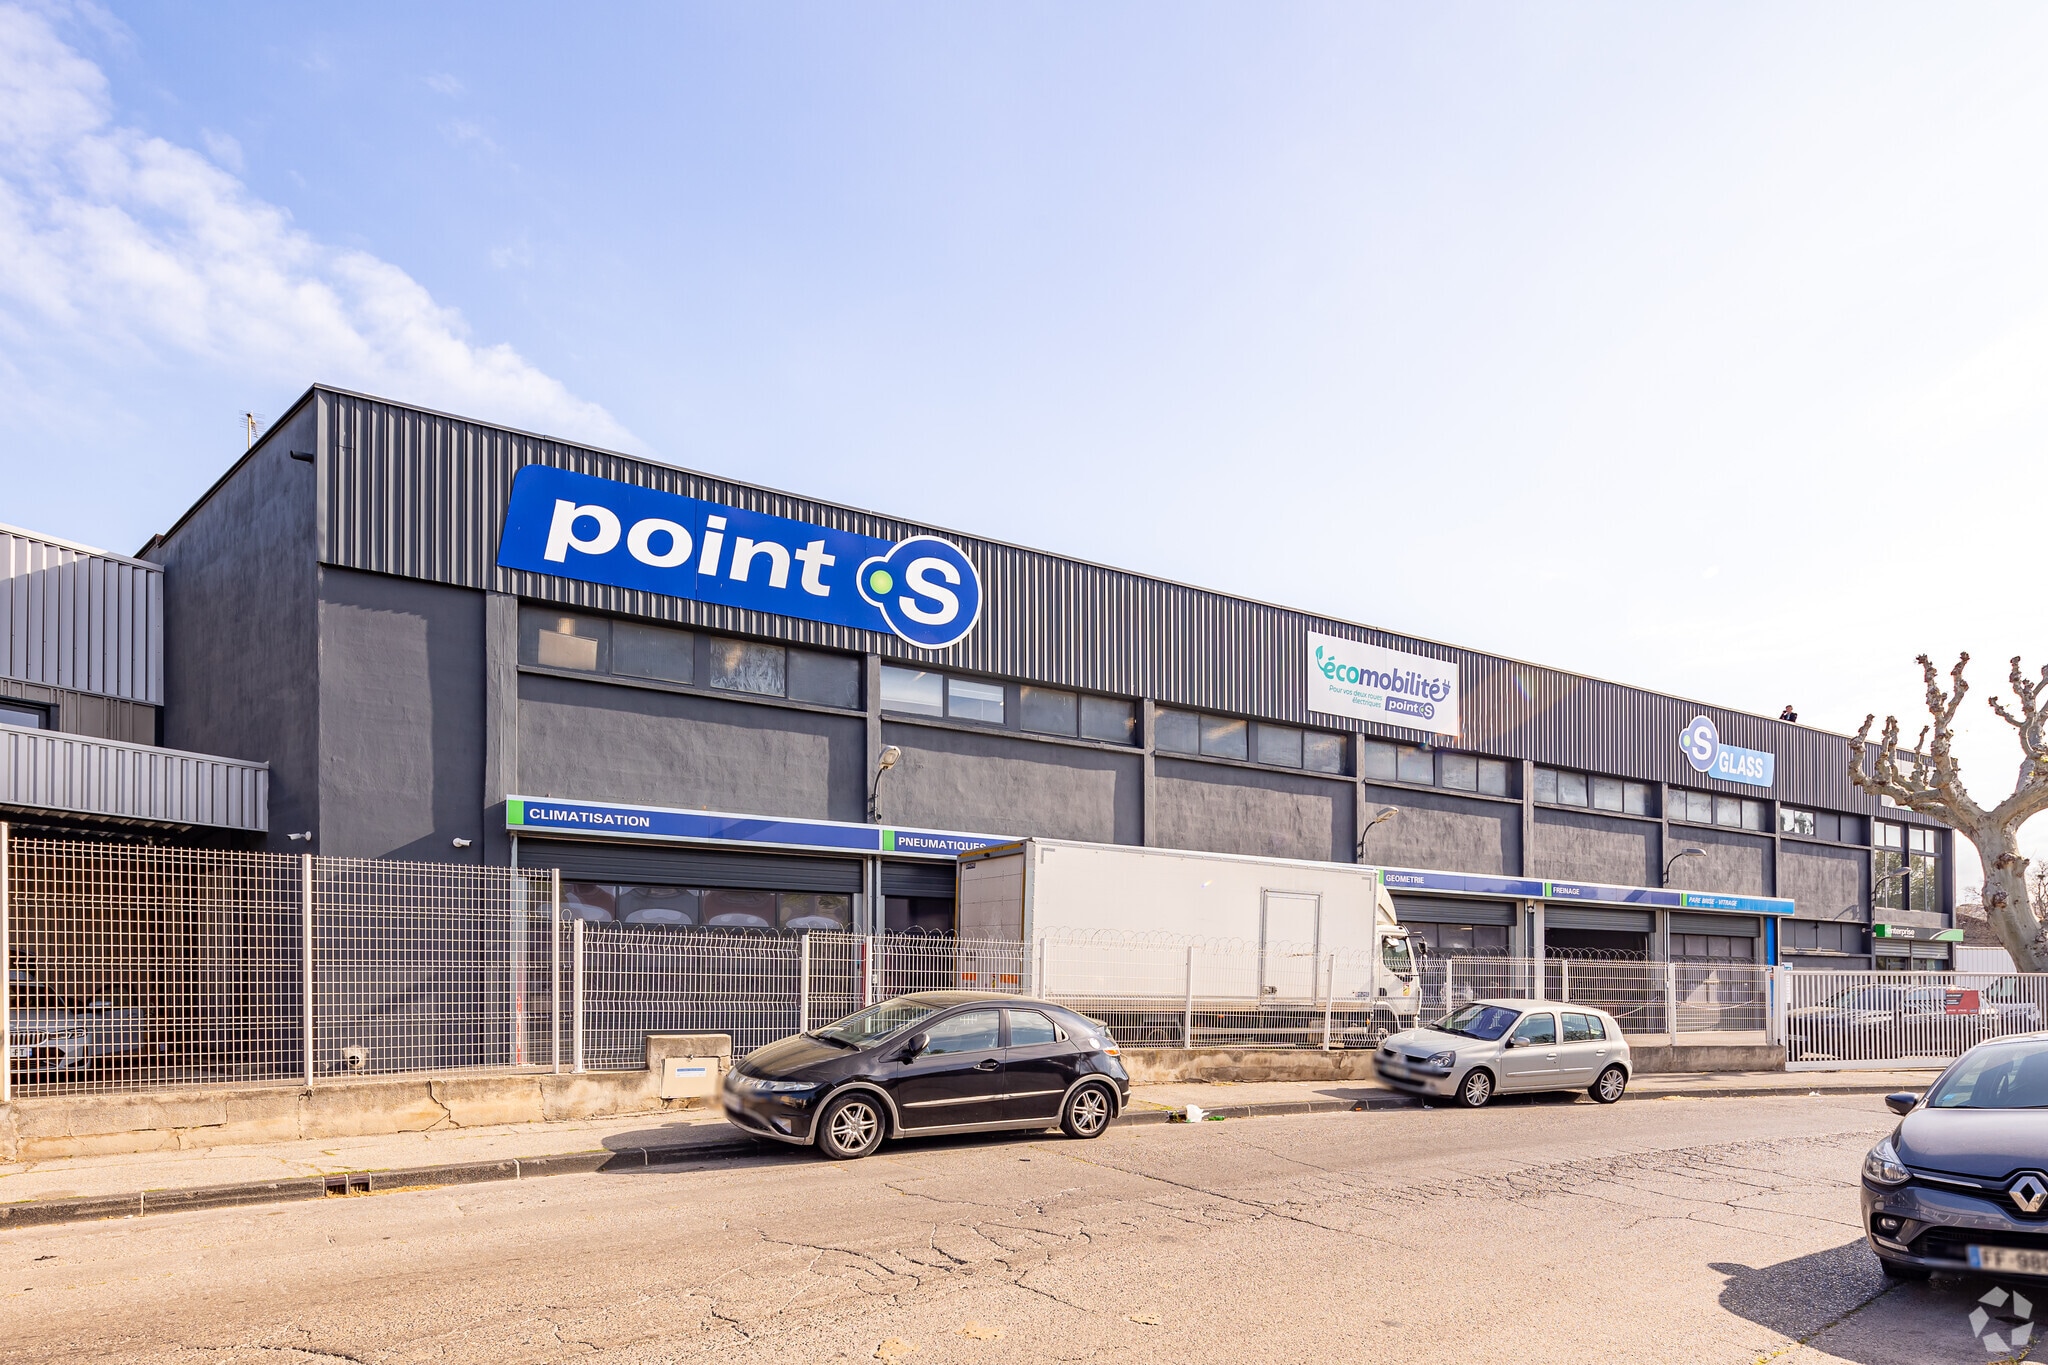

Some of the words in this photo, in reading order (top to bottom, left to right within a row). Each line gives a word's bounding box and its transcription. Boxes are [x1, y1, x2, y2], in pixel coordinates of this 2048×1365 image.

[544, 499, 835, 597] point
[899, 557, 962, 626] S
[1324, 656, 1443, 702] écomobilité
[1329, 685, 1343, 693] Pour
[1353, 690, 1367, 699] deux
[1352, 697, 1382, 708] électriques
[1388, 700, 1419, 713] point
[1424, 705, 1433, 718] S
[1692, 726, 1713, 761] S
[1718, 751, 1764, 778] GLASS
[529, 808, 650, 827] CLIMATISATION
[1385, 874, 1425, 884] GEOMETRIE
[1552, 886, 1580, 896] FREINAGE
[1886, 927, 1915, 937] enterprise
